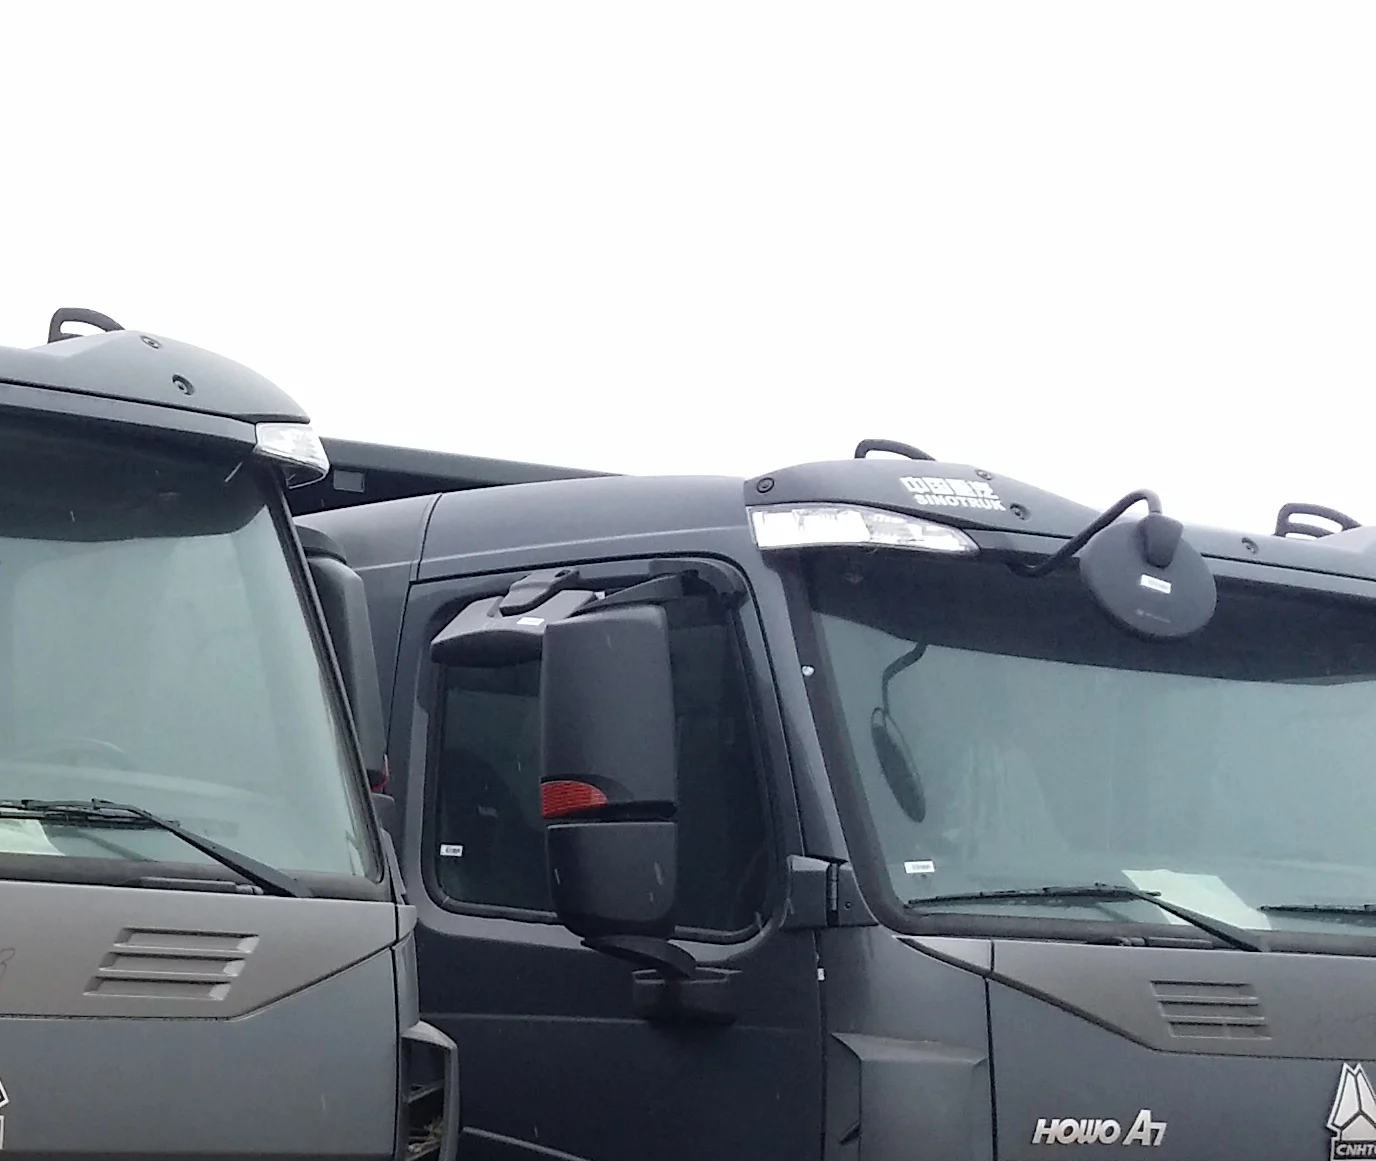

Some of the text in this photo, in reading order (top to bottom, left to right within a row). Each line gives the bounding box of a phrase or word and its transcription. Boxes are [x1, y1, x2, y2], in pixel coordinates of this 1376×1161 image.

[913, 493, 1007, 512] SINOTRUK
[1031, 1108, 1168, 1147] HOWO A7
[1335, 1143, 1376, 1156] CNHT
